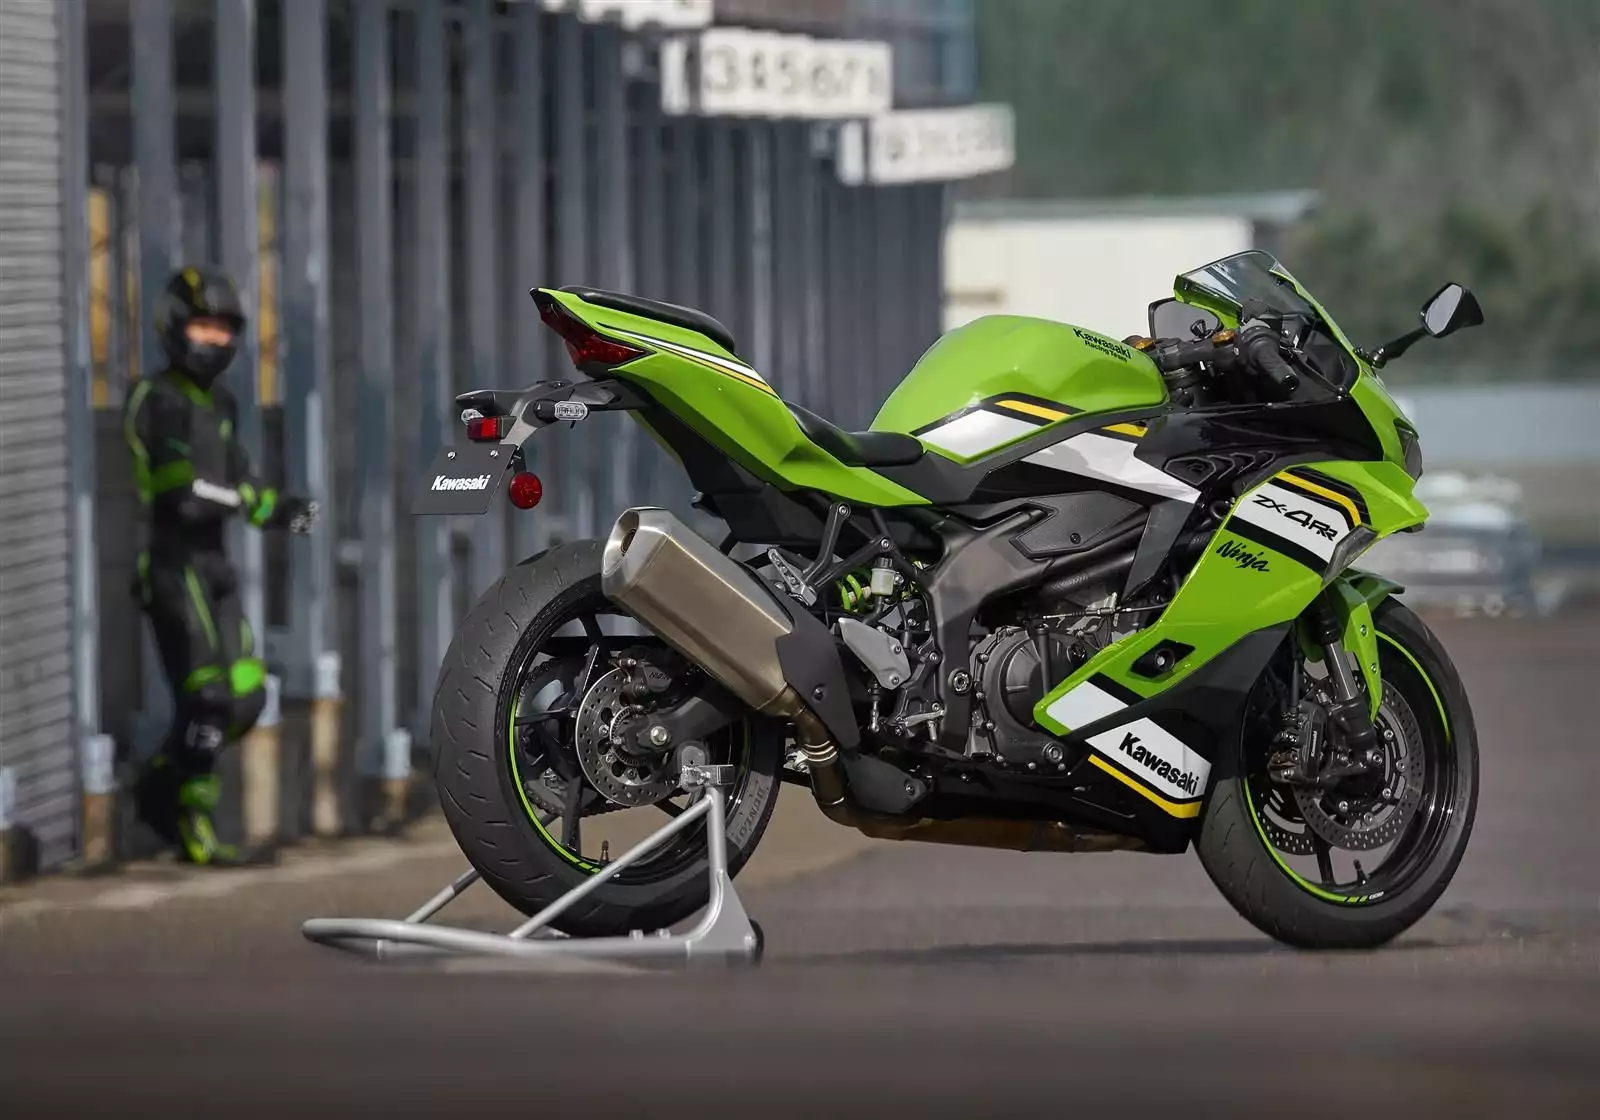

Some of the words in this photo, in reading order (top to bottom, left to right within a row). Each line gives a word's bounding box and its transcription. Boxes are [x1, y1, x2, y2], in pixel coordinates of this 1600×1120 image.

[1072, 328, 1132, 359] Kawasaki
[1084, 340, 1110, 356] Racing
[1109, 349, 1128, 363] Team
[431, 474, 491, 491] Kawasaki
[1252, 494, 1338, 542] ZX-4RR
[1215, 540, 1270, 572] Ninja
[1118, 732, 1199, 796] Kawasaki
